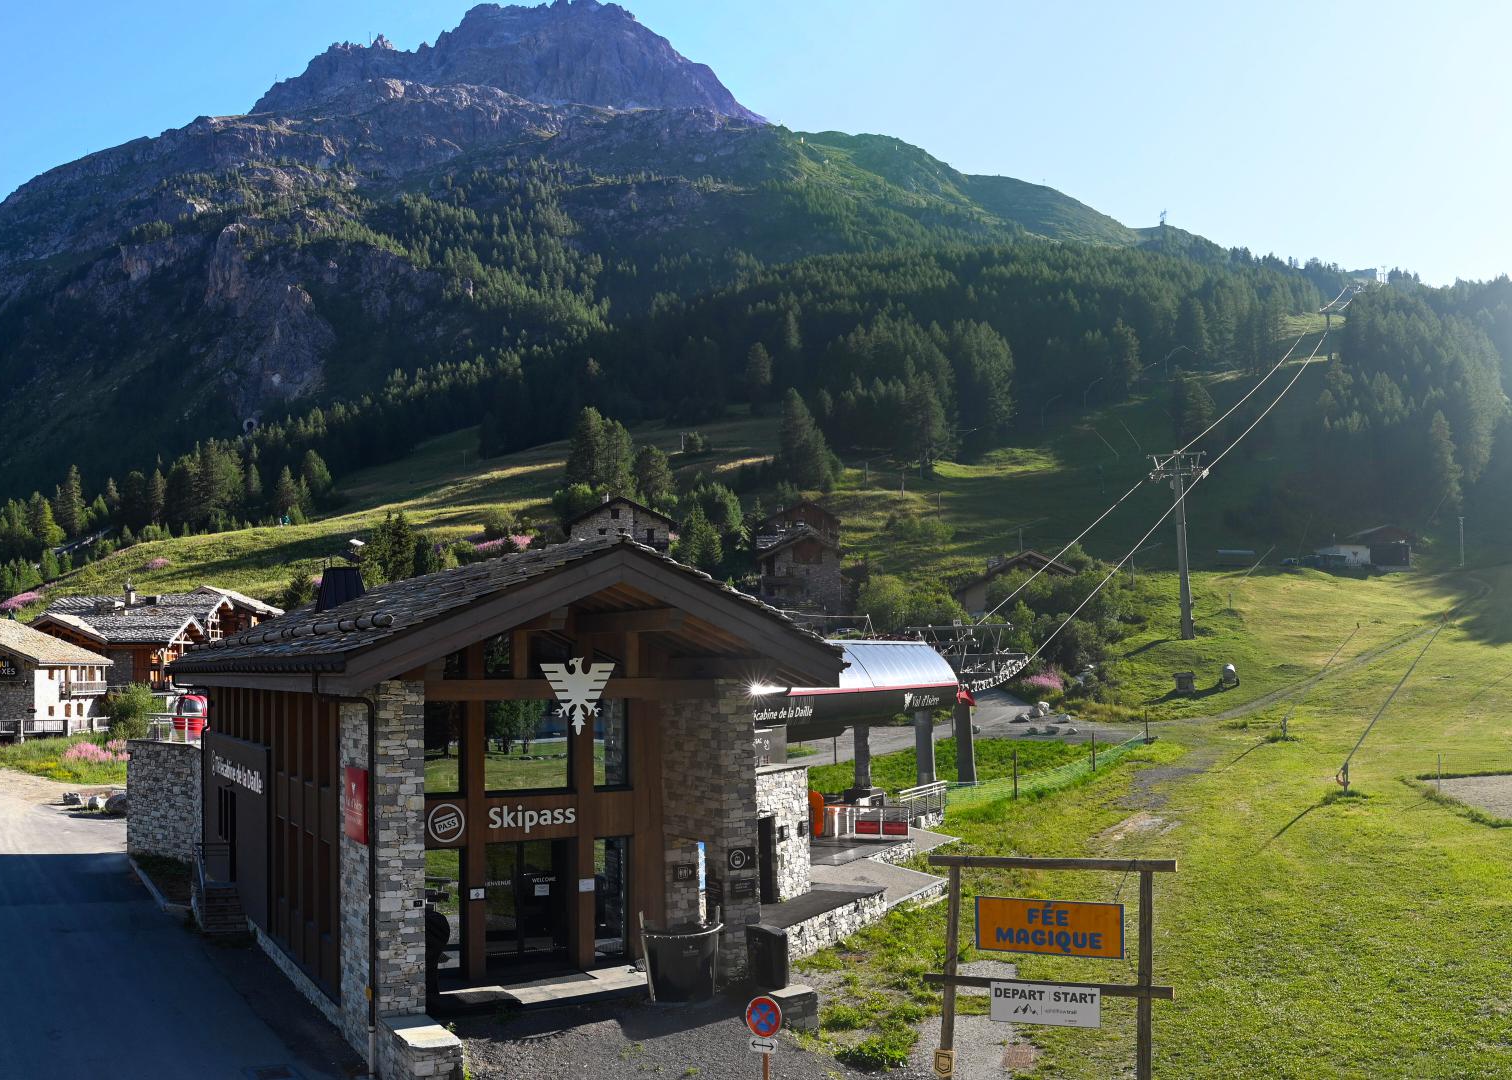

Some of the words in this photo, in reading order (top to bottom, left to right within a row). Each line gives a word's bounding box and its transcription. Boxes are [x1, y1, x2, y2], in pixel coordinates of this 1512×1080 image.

[778, 707, 787, 719] de
[787, 706, 795, 718] la
[795, 705, 813, 718] Daille
[248, 769, 264, 795] Daille
[438, 818, 458, 832] PASS
[488, 804, 576, 833] Skipass
[531, 876, 557, 884] WELCOME
[1027, 902, 1070, 927] FÉE
[995, 927, 1104, 953] MAGIQUE
[994, 987, 1046, 1001] DEPART
[1053, 991, 1097, 1004] START
